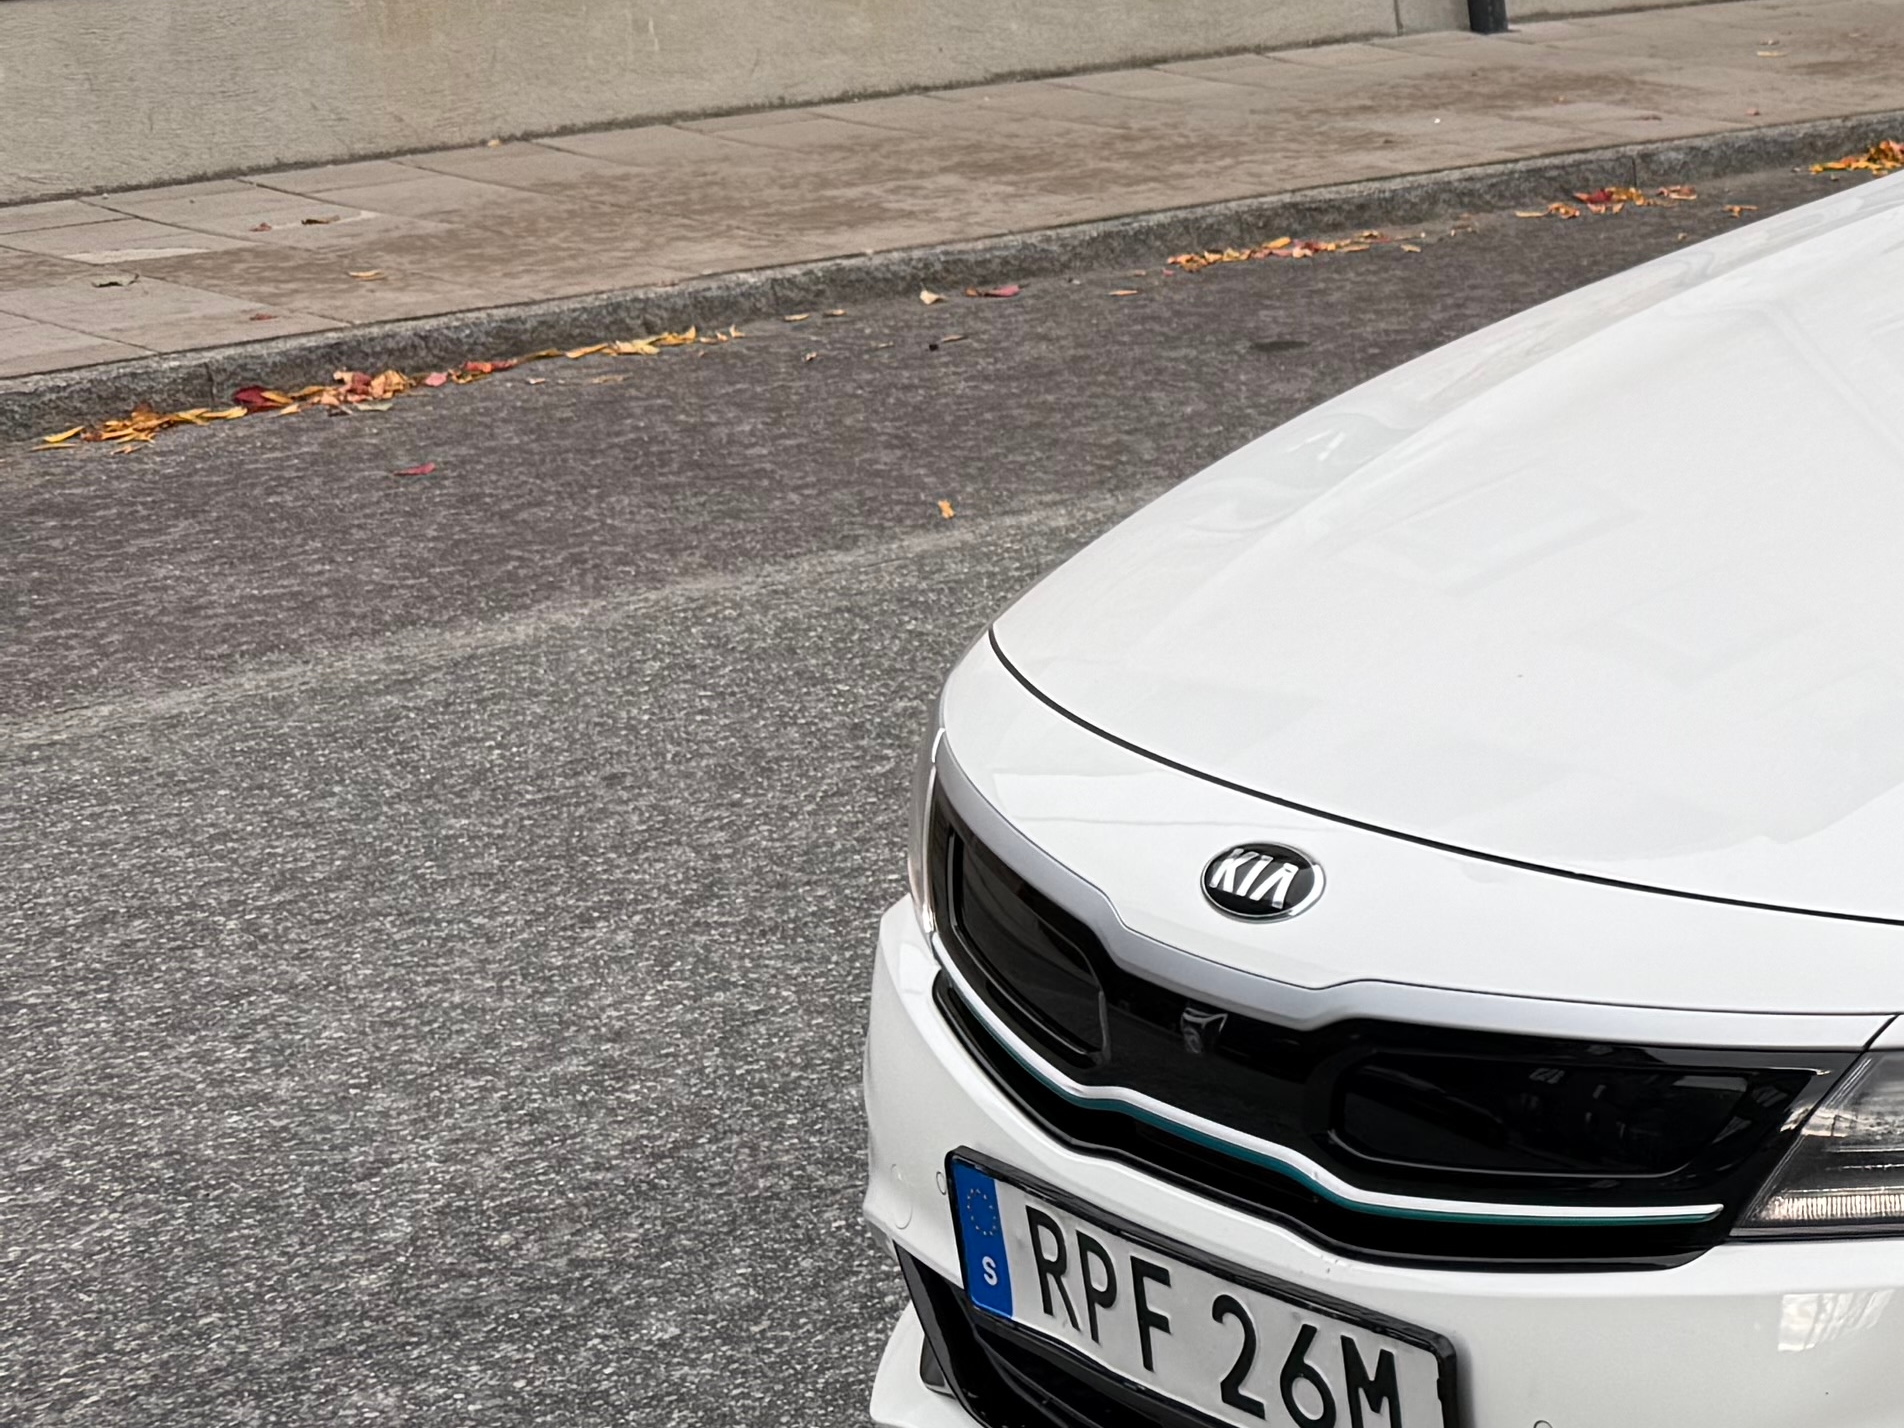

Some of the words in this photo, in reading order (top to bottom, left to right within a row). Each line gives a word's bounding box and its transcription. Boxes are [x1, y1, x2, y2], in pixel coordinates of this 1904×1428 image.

[1209, 847, 1299, 910] KIA
[982, 1254, 999, 1288] S
[1024, 1204, 1175, 1374] RPF
